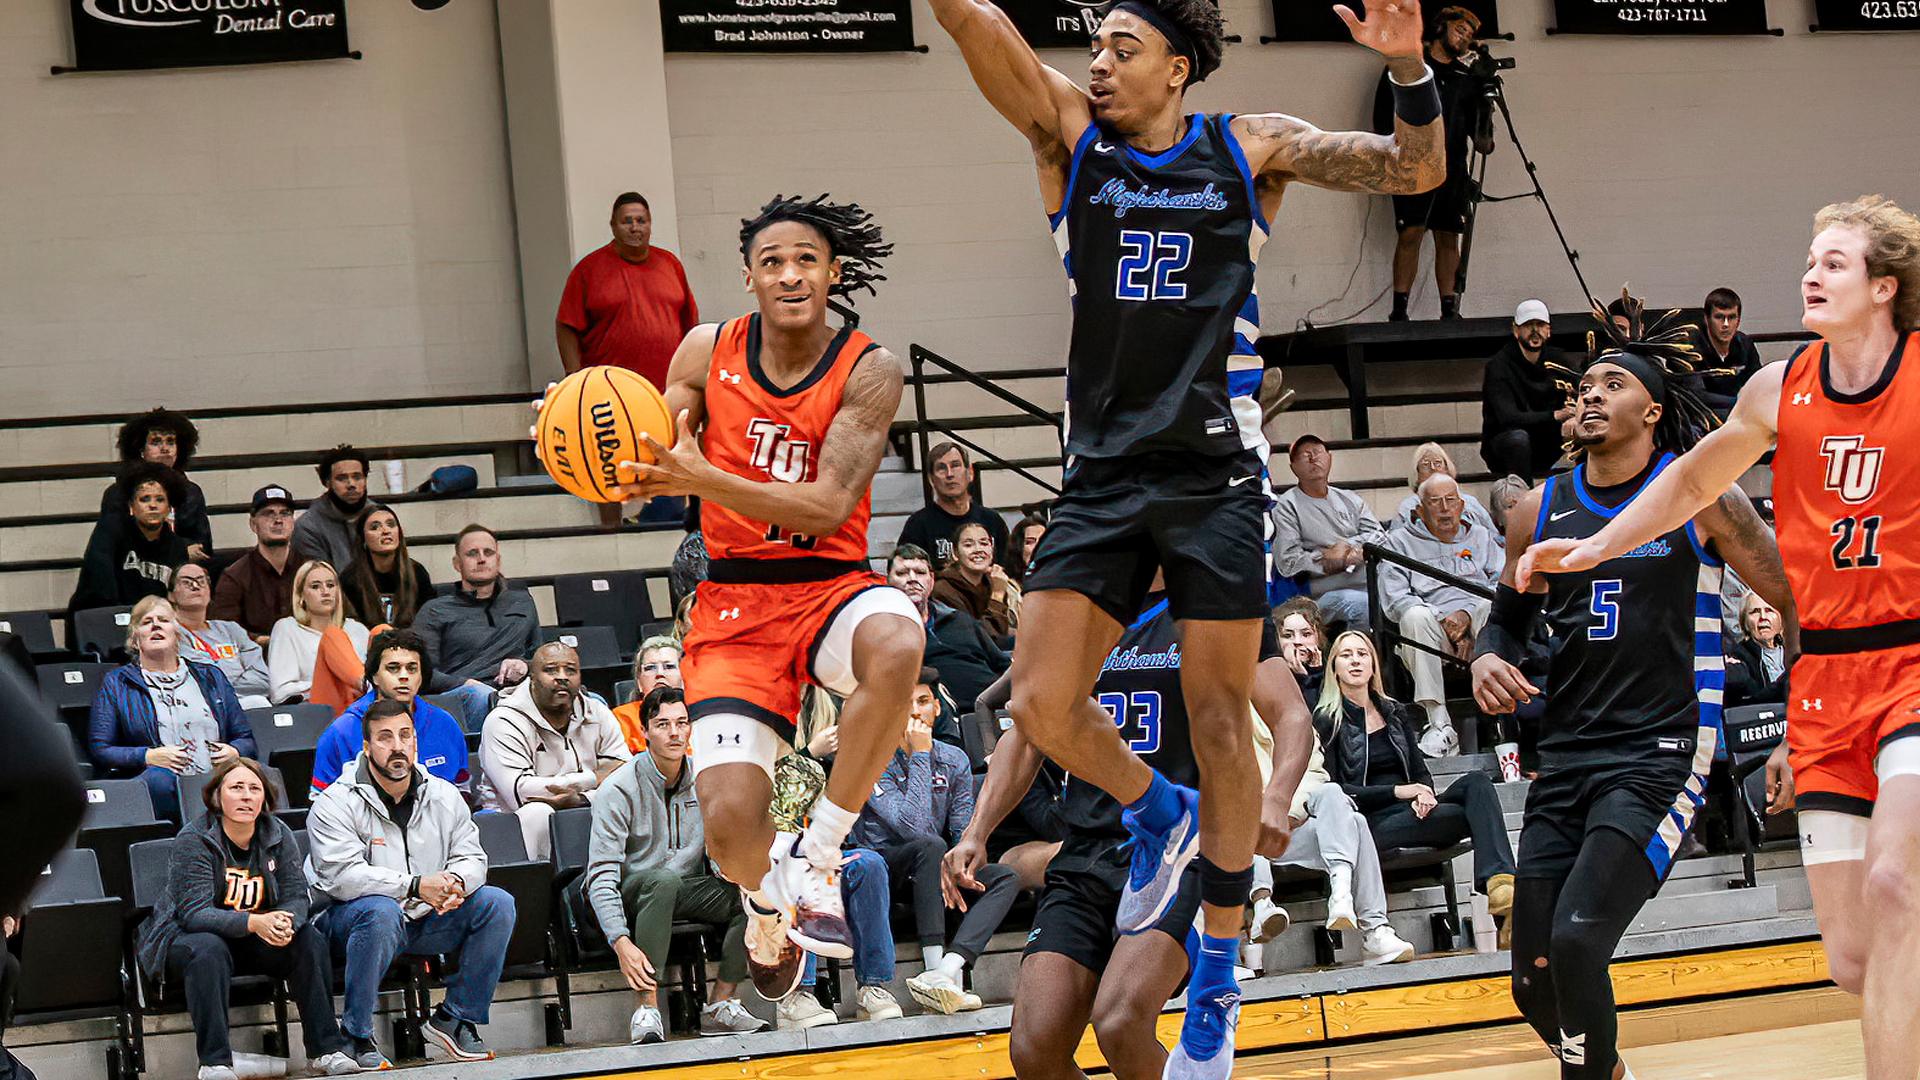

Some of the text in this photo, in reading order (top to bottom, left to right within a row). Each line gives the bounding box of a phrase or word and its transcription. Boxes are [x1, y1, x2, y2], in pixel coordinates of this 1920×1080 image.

[215, 9, 336, 34] Dental Care
[1617, 9, 1707, 21] 423-787-1711
[1861, 1, 1920, 18] 423.63
[714, 30, 746, 41] Brad
[750, 30, 809, 41] Johnston
[821, 29, 864, 40] Owner
[1116, 230, 1193, 300] 22
[591, 401, 620, 489] Wilson
[746, 417, 810, 483] TU
[1820, 435, 1885, 505] TU
[1830, 515, 1882, 571] 21
[1587, 579, 1622, 640] 5
[1740, 720, 1787, 743] RESERV
[225, 867, 264, 911] TU
